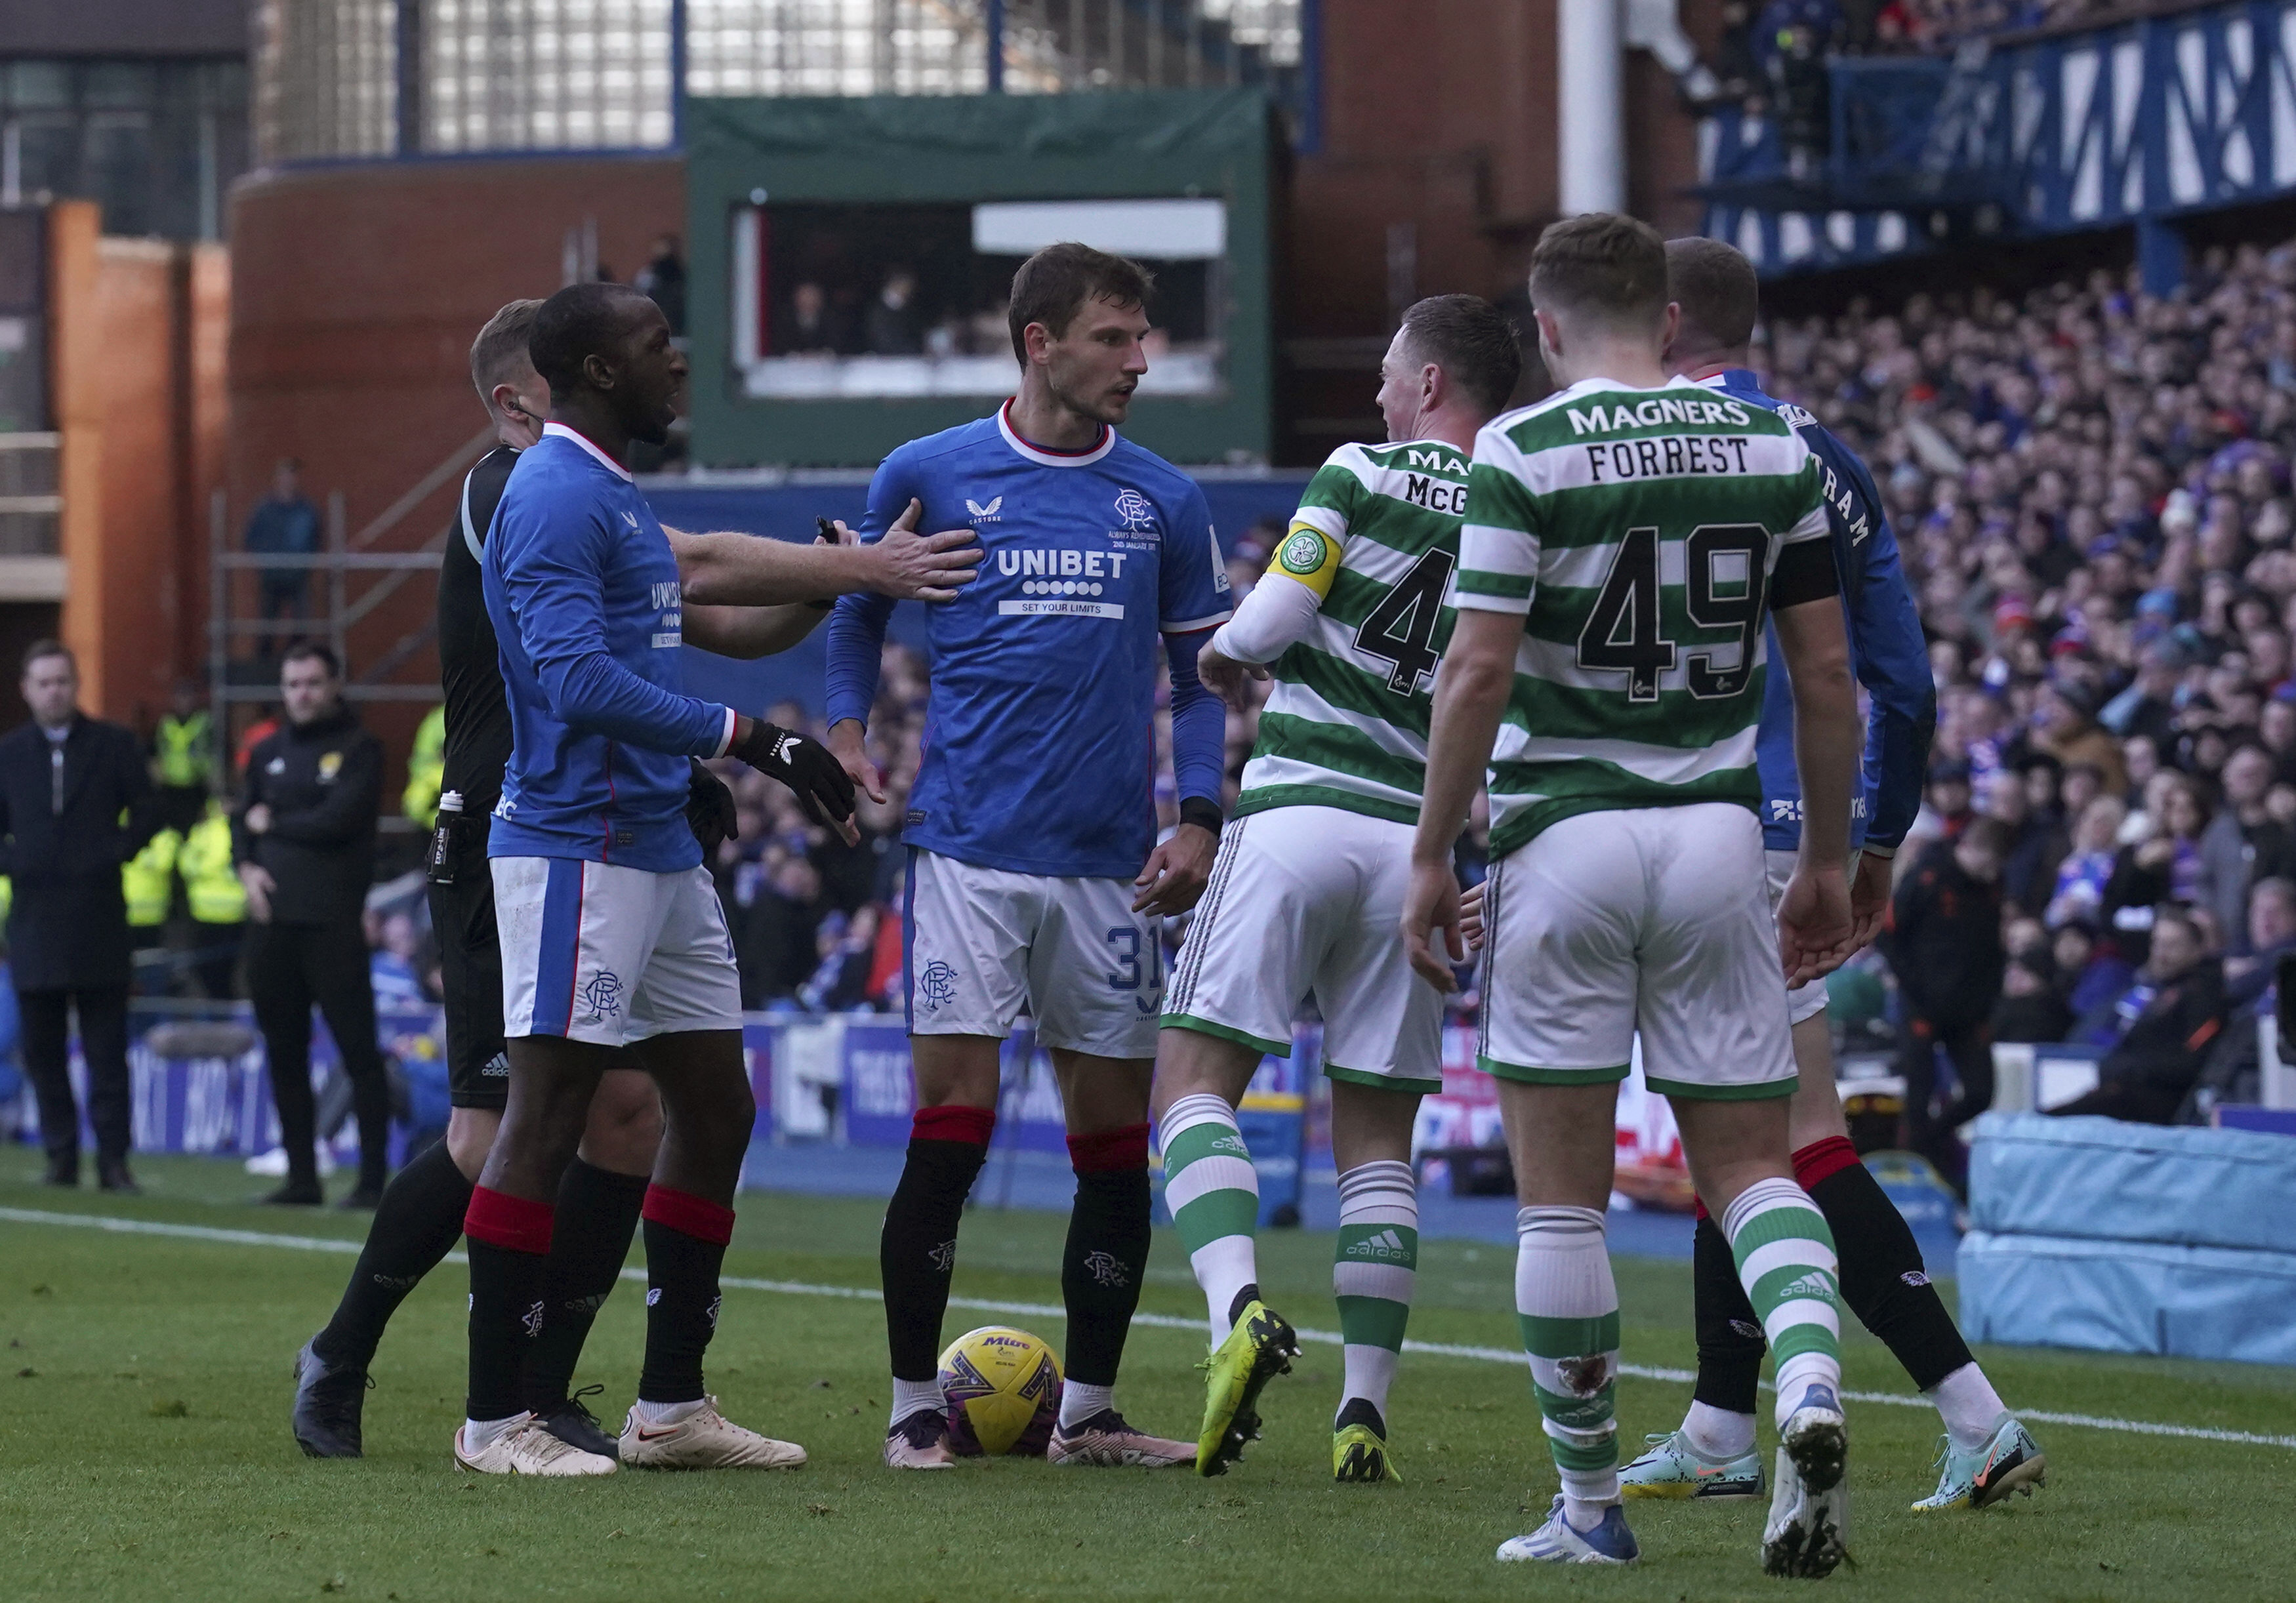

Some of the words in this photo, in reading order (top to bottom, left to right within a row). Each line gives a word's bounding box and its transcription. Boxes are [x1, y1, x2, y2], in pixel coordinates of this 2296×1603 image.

[1566, 399, 1750, 436] MAGNERS
[1586, 437, 1748, 481] FORREST
[968, 516, 1001, 525] CASTORE
[998, 549, 1127, 578] UNIBET
[1022, 603, 1038, 612] SET
[1042, 603, 1068, 612] YOUR
[1070, 604, 1101, 614] LIMITS
[1351, 546, 1456, 698] 4
[1576, 522, 1773, 702] 49
[1105, 925, 1162, 992] 31
[482, 1066, 509, 1077] adida
[1346, 1244, 1410, 1260] adidas
